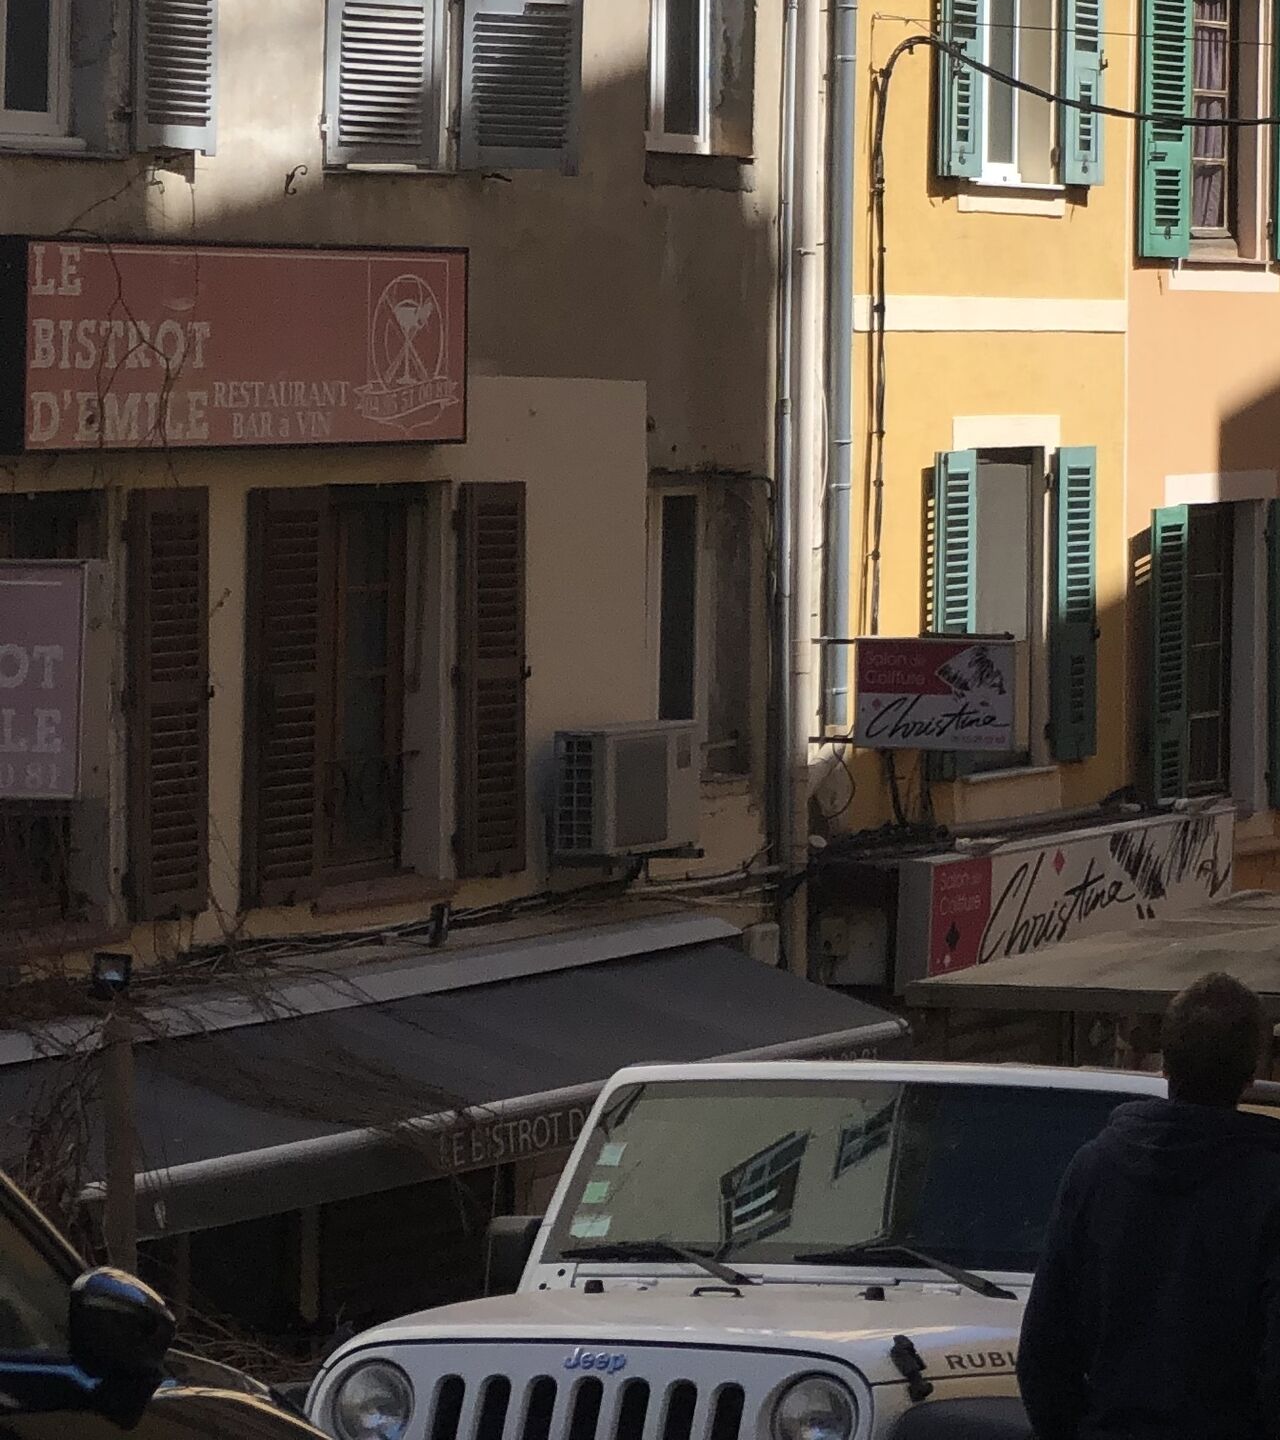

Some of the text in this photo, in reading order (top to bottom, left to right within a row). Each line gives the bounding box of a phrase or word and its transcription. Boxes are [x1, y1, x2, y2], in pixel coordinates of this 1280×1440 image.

[30, 245, 82, 296] LE
[29, 318, 211, 369] BISTROT
[213, 380, 349, 408] RESTAURANT
[29, 391, 210, 442] D'EMILE
[232, 411, 273, 438] BAR
[295, 411, 330, 438] VIN
[865, 669, 926, 686] Coiffure
[866, 694, 1010, 738] Christine
[979, 852, 1136, 966] Christine
[564, 1347, 627, 1374] Jeep
[945, 1351, 1016, 1370] RUBI
